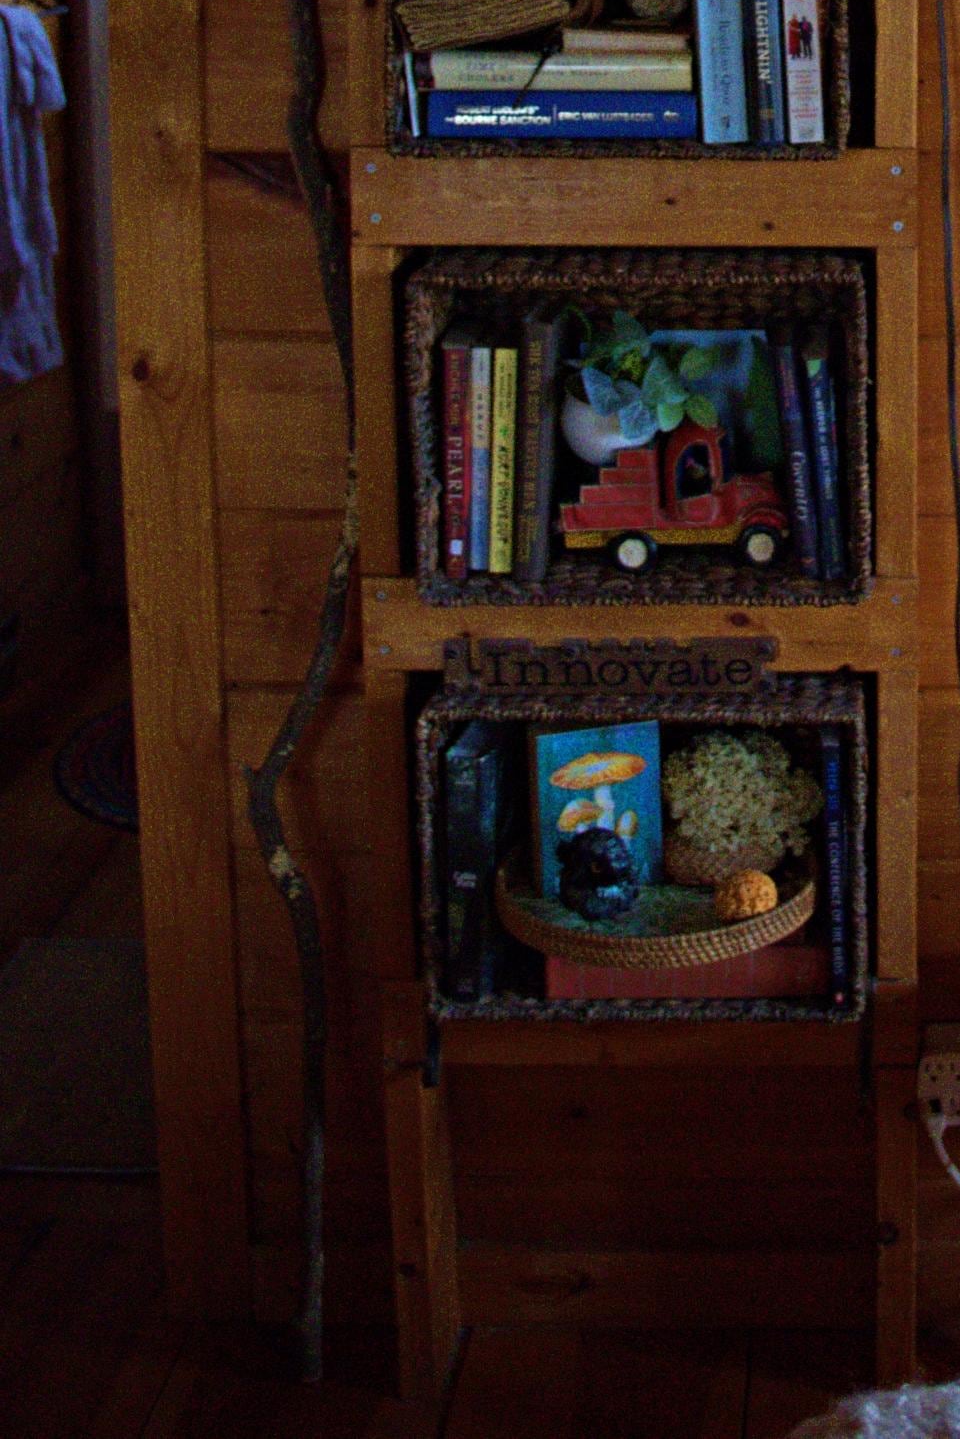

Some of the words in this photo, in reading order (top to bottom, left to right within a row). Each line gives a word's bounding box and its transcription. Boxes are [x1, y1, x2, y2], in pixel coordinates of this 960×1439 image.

[755, 0, 773, 85] LIGHTNIN'
[454, 115, 499, 126] BOURNE
[499, 115, 552, 126] SANCTION
[558, 111, 581, 122] ERIC
[815, 400, 826, 434] KEEPER
[446, 435, 464, 505] PEARL
[820, 445, 831, 467] LOST
[791, 450, 808, 521] Coventry
[823, 469, 834, 500] THINGS
[486, 651, 754, 686] Innovate
[828, 820, 841, 838] THE
[829, 842, 842, 906] CONFERENCE
[832, 908, 843, 923] OF
[832, 925, 844, 943] THE
[832, 946, 846, 976] BIRDS
